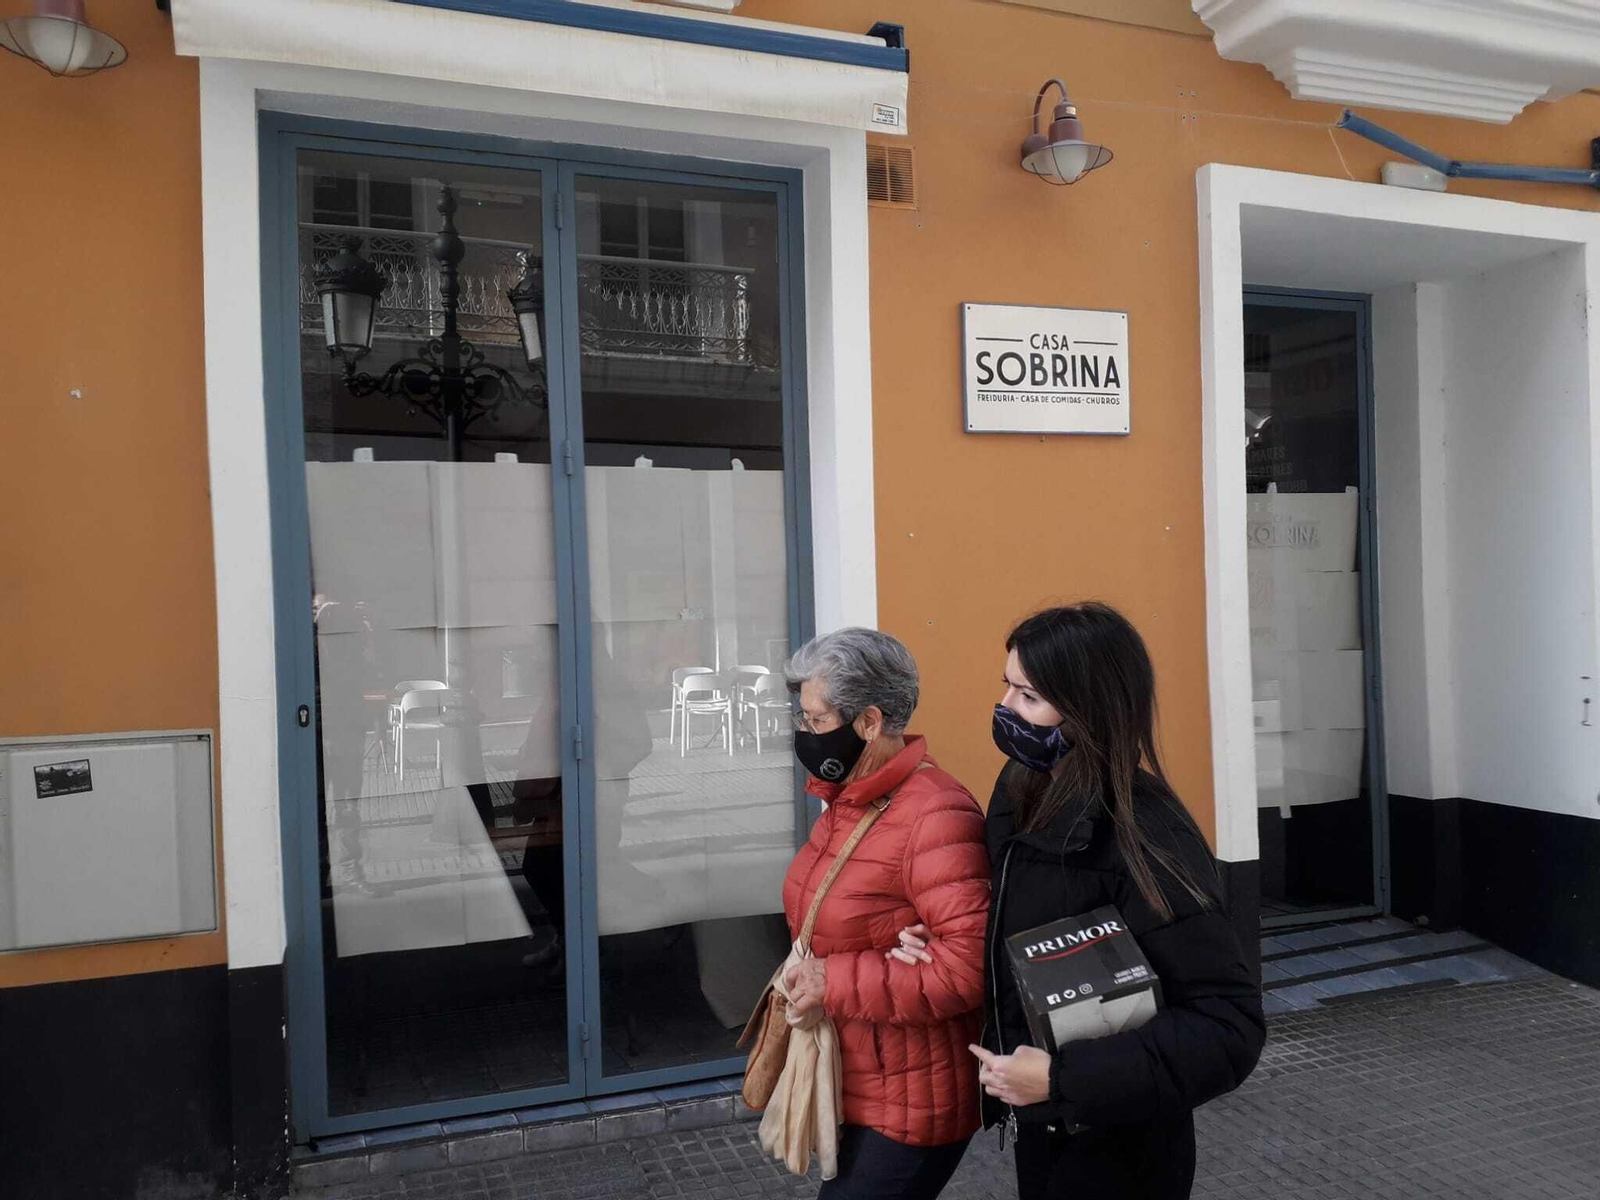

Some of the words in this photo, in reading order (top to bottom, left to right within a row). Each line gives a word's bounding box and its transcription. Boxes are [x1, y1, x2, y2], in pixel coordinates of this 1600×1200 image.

[1030, 333, 1069, 351] CASA
[975, 351, 1121, 389] SOBRINA
[1020, 395, 1040, 403] CASA
[1041, 395, 1049, 403] DE
[1086, 396, 1121, 405] CHURROS
[1024, 920, 1124, 958] PRIMOR
